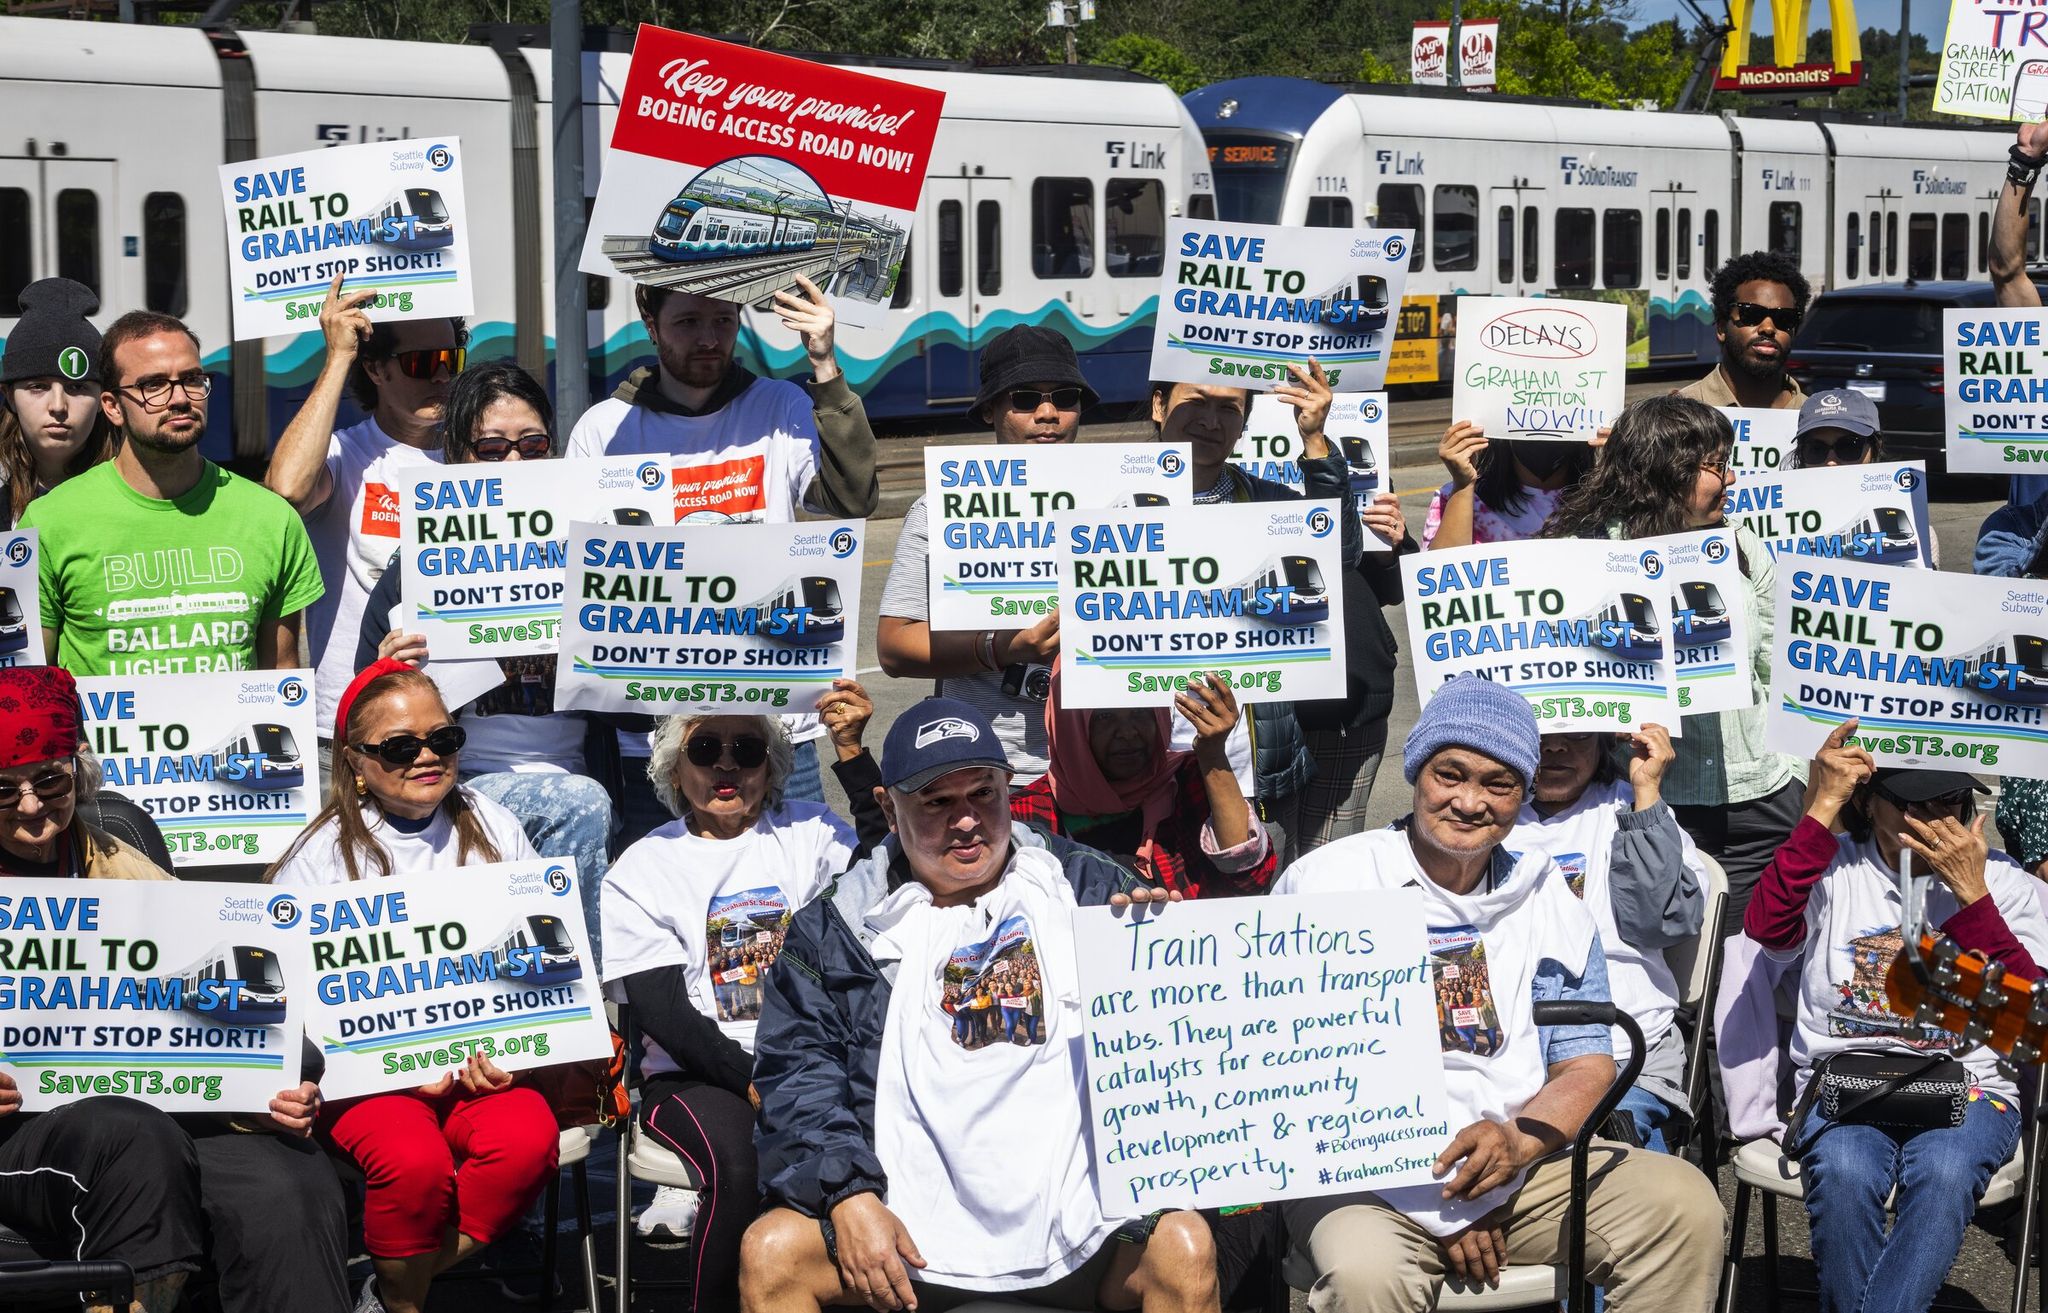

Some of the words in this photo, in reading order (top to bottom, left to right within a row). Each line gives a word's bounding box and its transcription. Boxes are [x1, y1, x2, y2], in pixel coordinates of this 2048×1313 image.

[1418, 54, 1443, 70] hello
[1465, 51, 1492, 68] hello
[1947, 43, 2014, 62] GRAHAM
[1415, 70, 1443, 78] Othello
[1463, 68, 1492, 76] Othello
[1739, 70, 1829, 85] McDonald's
[1948, 61, 2010, 81] STREET
[659, 59, 727, 103] Keep
[722, 82, 795, 112] your
[788, 93, 915, 135] promise!
[1941, 80, 2010, 104] STATION
[637, 95, 717, 131] BOEING
[719, 114, 794, 148] ACCESS
[798, 130, 854, 160] ROAD
[858, 144, 914, 173] NOW!
[390, 161, 424, 172] Subway
[393, 151, 423, 160] Seattle
[1130, 142, 1165, 169] Link
[1224, 146, 1276, 162] SERVICE
[1396, 152, 1424, 175] Link
[234, 167, 306, 202] SAVE
[1317, 177, 1348, 192] 111A
[1775, 171, 1795, 190] Link
[239, 201, 303, 233] RAIL
[310, 193, 349, 220] TO
[242, 219, 372, 261] GRAHAM
[383, 215, 419, 241] ST
[1180, 232, 1265, 263] SAVE
[1354, 239, 1381, 248] Seattle
[1350, 249, 1381, 260] Subway
[1178, 261, 1252, 291] RAIL
[1264, 268, 1305, 294] TO
[1174, 289, 1322, 324] GRAHAM
[1330, 299, 1365, 325] ST
[1491, 325, 1582, 349] DELAYS
[1957, 321, 2040, 347] SAVE
[67, 352, 80, 375] 1
[1959, 351, 2033, 375] RAIL
[1465, 363, 1561, 391] GRAHAM
[1575, 371, 1607, 389] ST
[1512, 391, 1586, 406] STATION
[1507, 407, 1603, 430] NOW!!!
[598, 479, 634, 489] Subway
[602, 467, 633, 478] Seattle
[673, 482, 701, 497] your
[702, 468, 751, 495] promise!
[940, 460, 1026, 487] SAVE
[414, 478, 503, 511] SAVE
[674, 496, 707, 508] ACCESS
[710, 491, 732, 504] ROAD
[735, 485, 758, 498] NOW!
[1724, 485, 1783, 514] SAVE
[1267, 524, 1304, 536] Subway
[1270, 514, 1303, 524] Seattle
[789, 546, 826, 557] Subway
[794, 534, 826, 545] Seattle
[1071, 523, 1164, 554] SAVE
[583, 538, 685, 570] SAVE
[1608, 552, 1637, 563] Seattle
[104, 547, 243, 592] BUILD
[1073, 559, 1158, 588] RAIL
[1168, 556, 1219, 586] TO
[1417, 558, 1509, 597] SAVE
[1606, 563, 1638, 576] Subway
[582, 571, 672, 602] RAIL
[685, 576, 736, 603] TO
[1791, 571, 1890, 612] SAVE
[2007, 591, 2044, 603] Seattle
[1075, 588, 1243, 620] GRAHAM
[1256, 586, 1296, 614] ST
[1422, 593, 1504, 630] RAIL
[1515, 589, 1564, 616] TO
[2001, 602, 2043, 616] Subway
[579, 604, 756, 635] GRAHAM
[770, 607, 812, 635] ST
[1791, 606, 1876, 646] RAIL
[1890, 619, 1943, 652] TO
[108, 621, 249, 652] BALLARD
[1092, 634, 1163, 652] DON'T
[1170, 632, 1228, 650] STOP
[1235, 628, 1314, 648] SHORT!
[1426, 619, 1589, 662] GRAHAM
[1600, 619, 1635, 648] ST
[592, 646, 669, 664] DON'T
[676, 648, 737, 665] STOP
[744, 648, 828, 665] SHORT!
[1788, 640, 1965, 688] GRAHAM
[1978, 662, 2025, 692] ST
[626, 682, 790, 706] SaveST3.org
[1801, 684, 1874, 713] DON'T
[1880, 696, 1944, 718] STOP
[1950, 701, 2042, 725] SHORT!
[1845, 735, 1999, 765] aveST3.org
[508, 884, 543, 896] Subway
[510, 872, 541, 884] Seattle
[219, 909, 263, 924] Subway
[224, 897, 263, 910] Seattle
[310, 891, 408, 935] SAVE
[721, 901, 748, 912] Graham
[759, 900, 783, 908] Station
[312, 931, 404, 971] RAIL
[414, 922, 467, 955] TO
[1000, 930, 1024, 943] Station
[1125, 919, 1217, 971] Train
[1234, 910, 1375, 959] Stations
[101, 938, 158, 971] TO
[318, 950, 497, 1006] GRAHAM
[508, 946, 546, 978] ST
[1092, 991, 1138, 1018] are
[1151, 982, 1227, 1009] more
[1244, 971, 1303, 999] than
[1320, 956, 1432, 1001] transport
[197, 979, 247, 1012] ST
[4, 1026, 86, 1047] DON'T
[93, 1026, 162, 1048] STOP
[169, 1028, 266, 1049] SHORT!
[1093, 1032, 1162, 1058] hubs.
[1169, 1015, 1232, 1050] They
[1241, 1018, 1278, 1037] are
[1293, 998, 1402, 1045] powerful
[382, 1033, 550, 1074] SaveST3.org
[1097, 1058, 1203, 1093] catalysts
[1219, 1051, 1250, 1075] for
[1262, 1039, 1387, 1068] economic
[39, 1070, 222, 1100] SaveST3.org
[1103, 1090, 1208, 1135] growth,
[1215, 1067, 1358, 1111] community
[1106, 1118, 1256, 1164] development
[1272, 1112, 1296, 1140] &
[1307, 1095, 1425, 1138] regional
[1128, 1148, 1295, 1203] prosperity.
